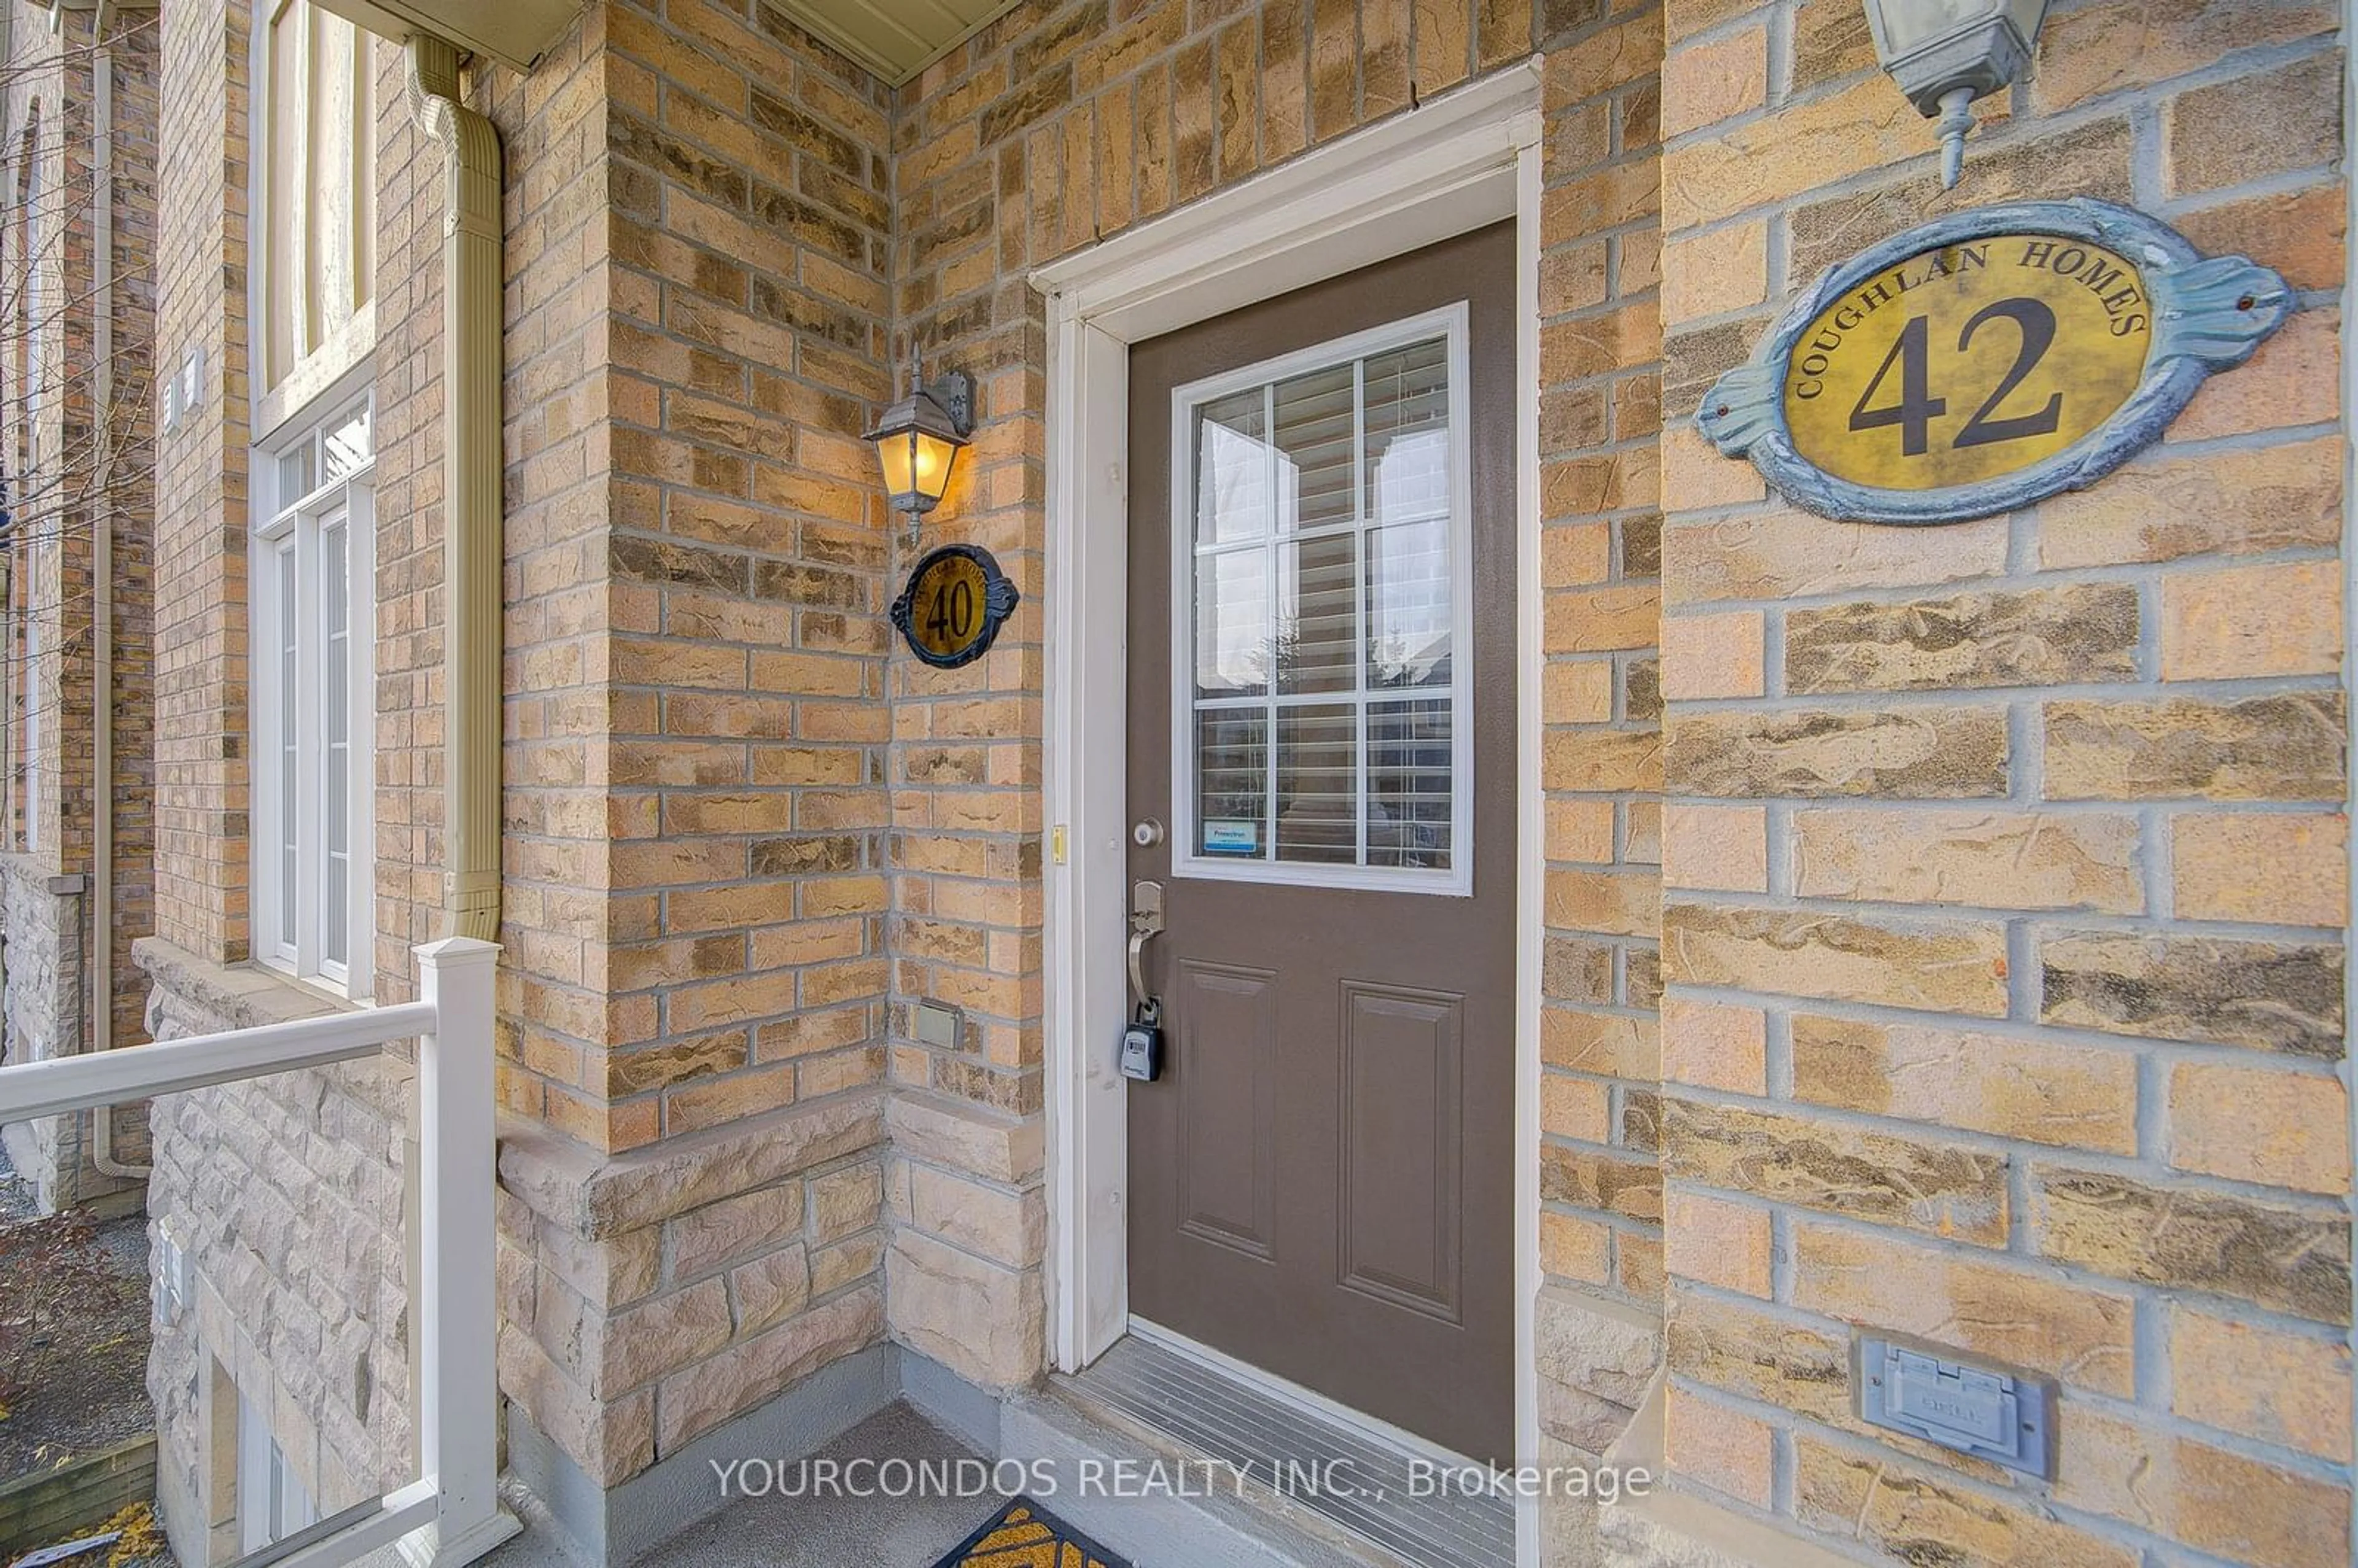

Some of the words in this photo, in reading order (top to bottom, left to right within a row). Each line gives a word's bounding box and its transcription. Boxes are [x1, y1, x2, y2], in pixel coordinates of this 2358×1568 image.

[1796, 245, 1990, 399] COUGHLAN
[2017, 242, 2146, 336] HOMES
[1849, 297, 2063, 456] 42
[927, 580, 972, 640] 40
